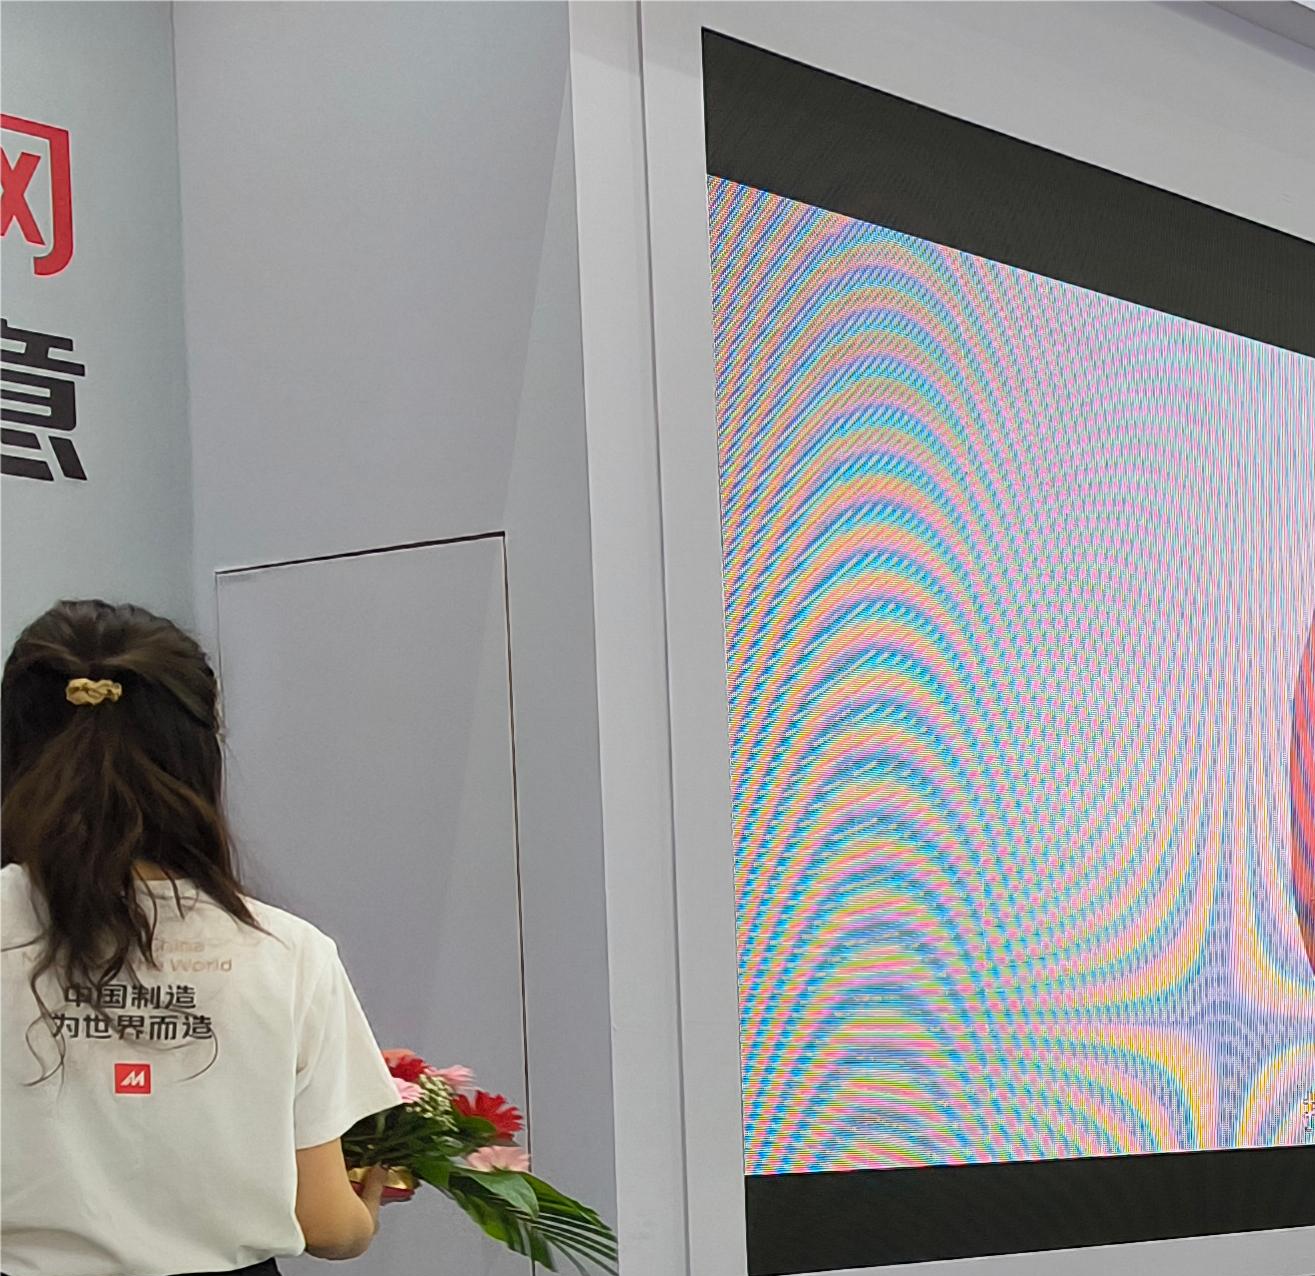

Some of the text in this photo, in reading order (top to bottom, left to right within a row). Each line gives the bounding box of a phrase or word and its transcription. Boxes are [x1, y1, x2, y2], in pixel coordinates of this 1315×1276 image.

[64, 982, 197, 1010] 中国制造
[51, 1013, 213, 1041] 为世界而造
